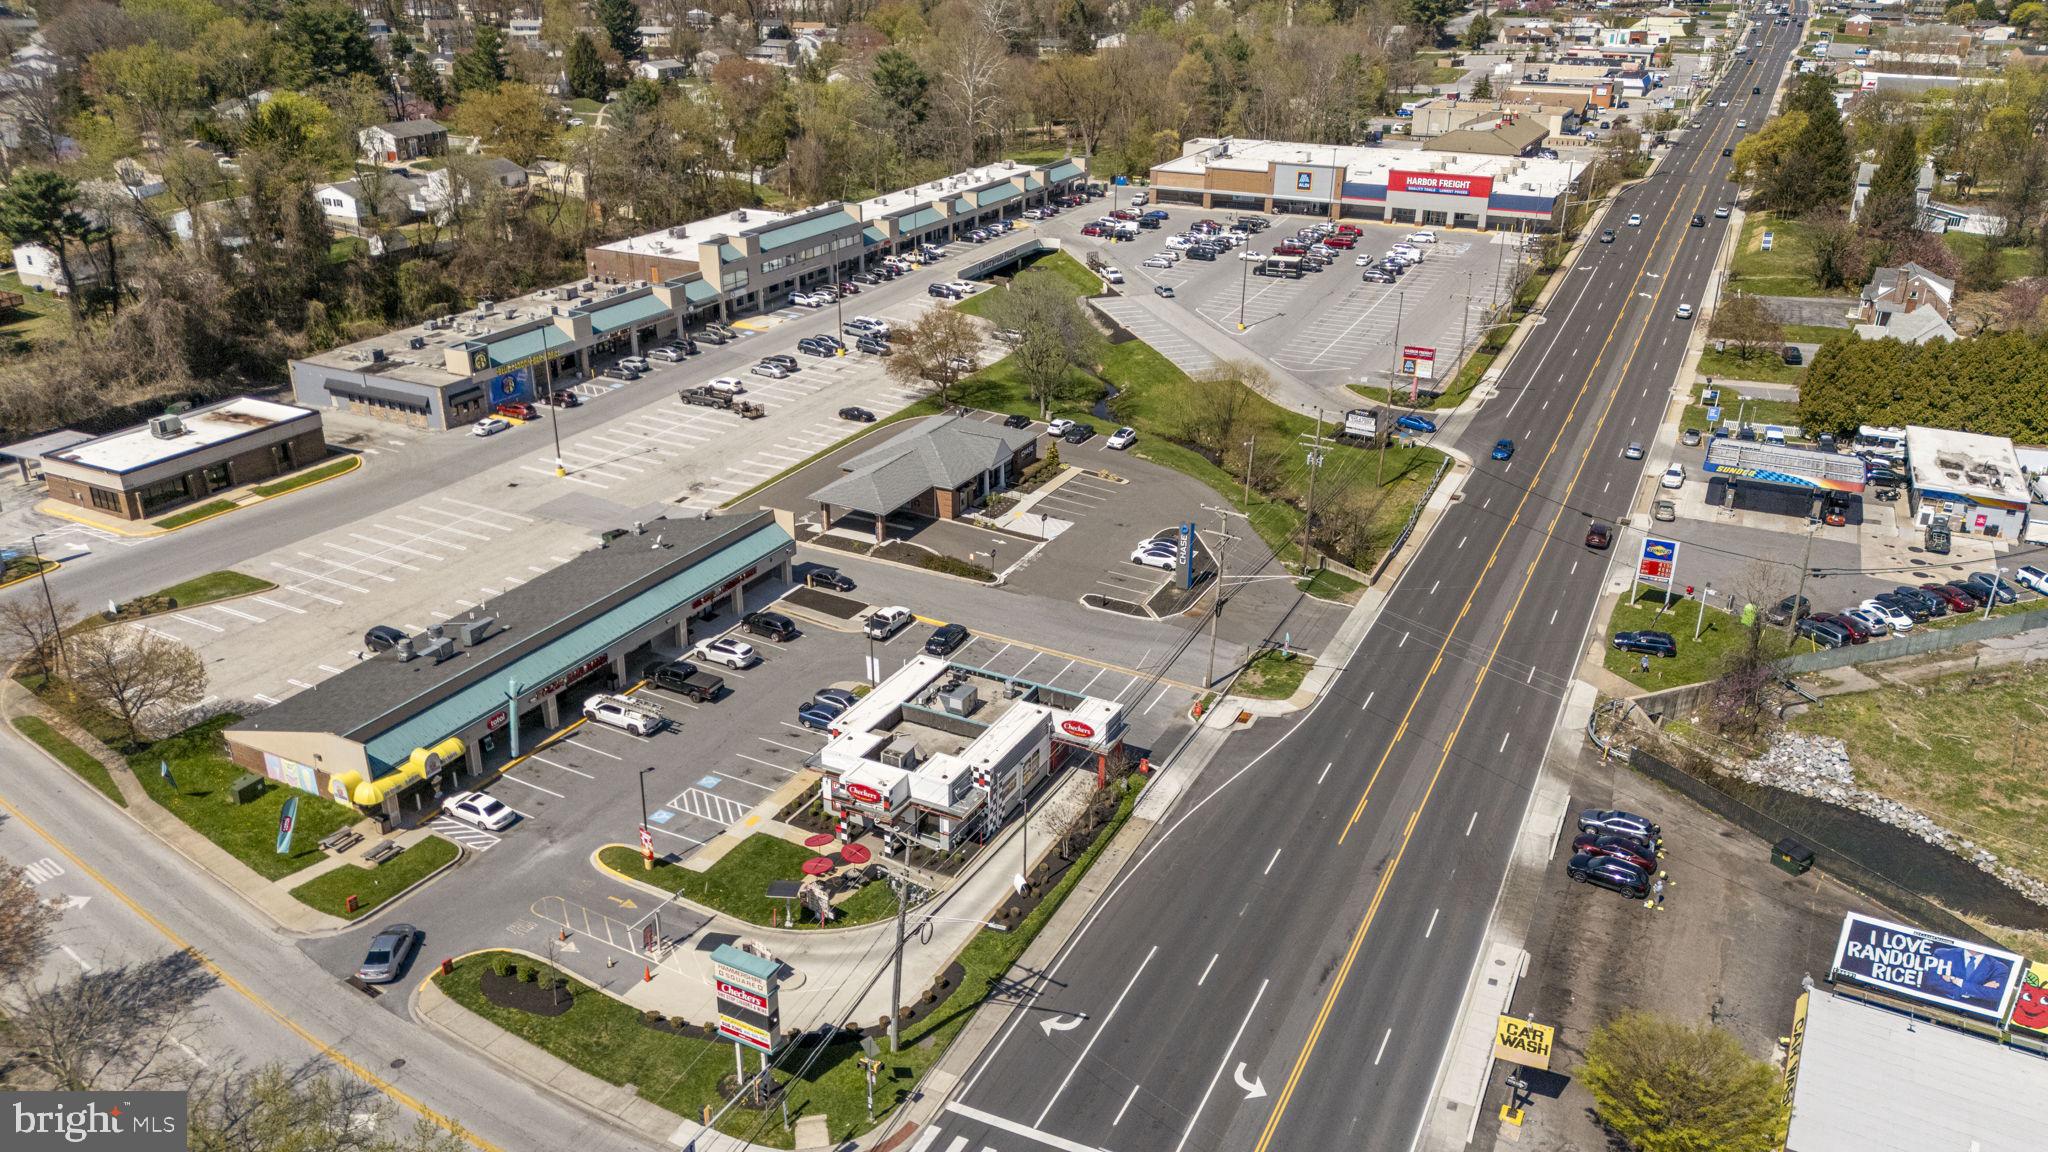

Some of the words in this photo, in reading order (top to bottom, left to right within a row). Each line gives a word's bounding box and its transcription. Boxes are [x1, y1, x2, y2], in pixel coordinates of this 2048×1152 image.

[1406, 177, 1437, 187] HARBOR
[1439, 179, 1471, 189] FREIGHT
[1715, 466, 1756, 477] SUNOCO
[1179, 534, 1188, 565] CHASE
[490, 712, 506, 727] total
[1063, 722, 1091, 735] Checkers
[849, 786, 878, 799] Checkers
[1870, 930, 1876, 945] I
[1883, 932, 1933, 955] LOVE
[1847, 941, 1953, 976] RANDOLPH
[725, 973, 755, 987] SQUARE
[1871, 962, 1924, 988] RICE!
[721, 984, 761, 1006] Checkers
[1506, 1022, 1544, 1042] CAR
[1499, 1033, 1549, 1056] WASH
